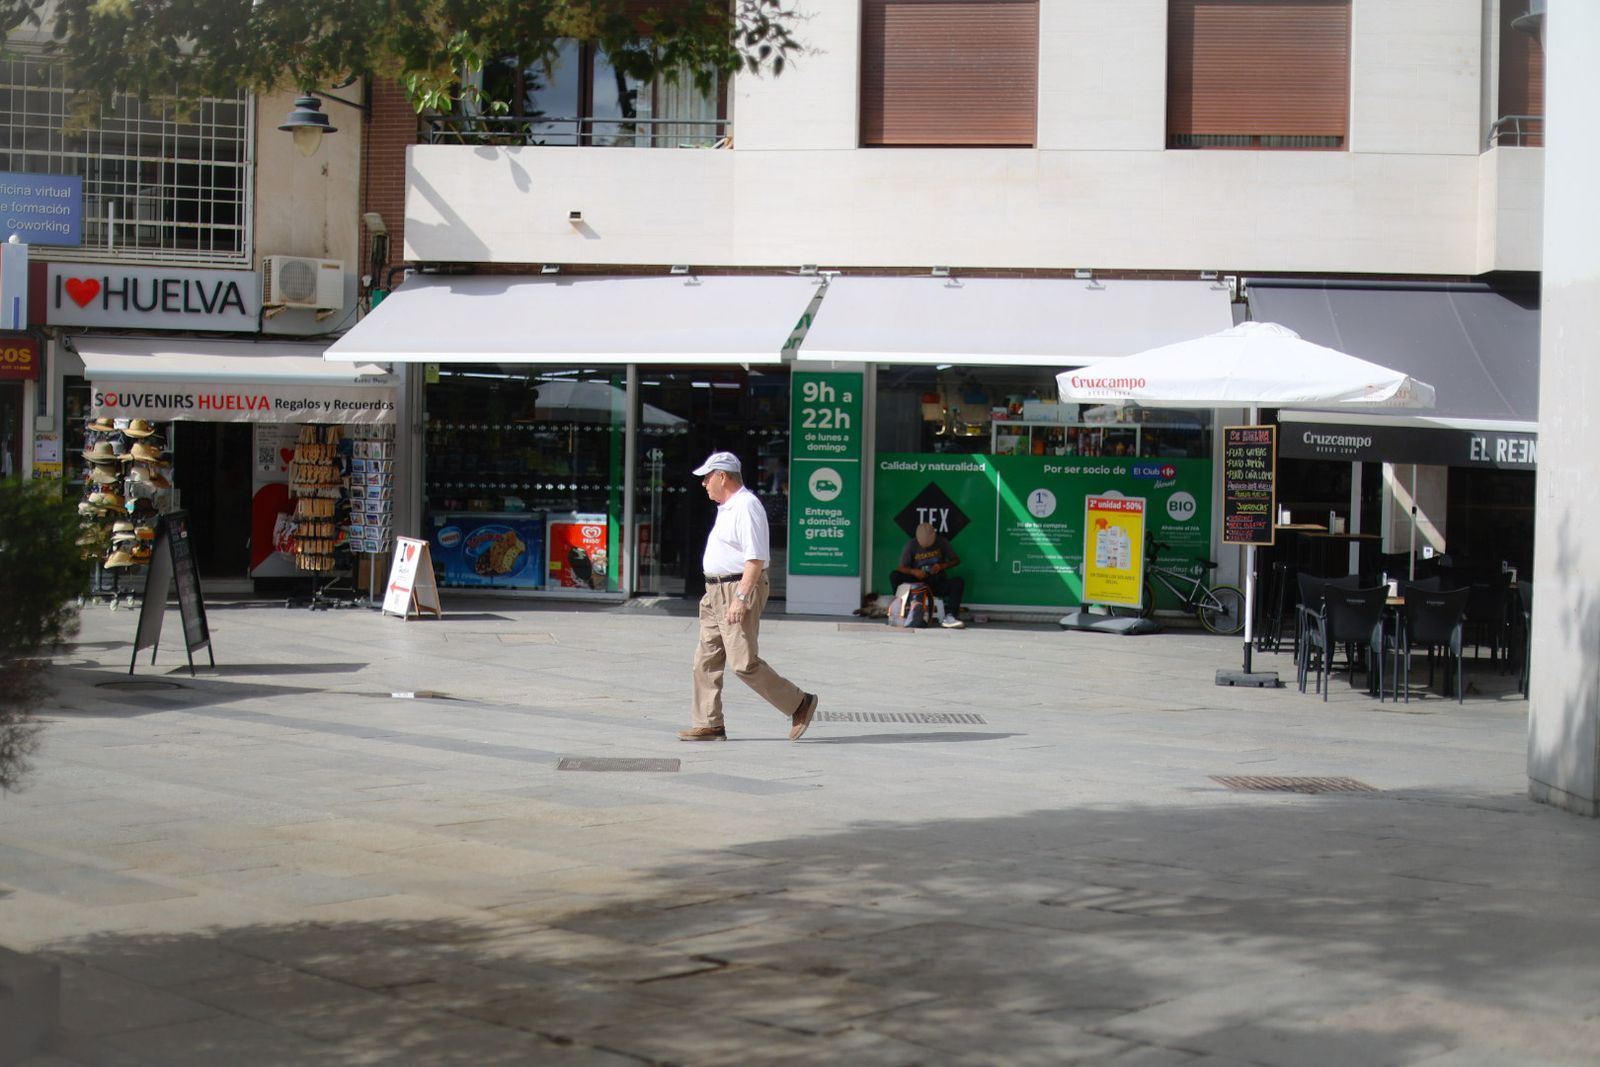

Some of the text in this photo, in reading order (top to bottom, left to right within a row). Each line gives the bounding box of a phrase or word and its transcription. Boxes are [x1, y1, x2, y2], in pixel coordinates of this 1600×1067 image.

[35, 186, 70, 198] virtual
[12, 202, 70, 215] formación
[8, 218, 70, 234] Coworking
[55, 274, 246, 315] I HUELVA
[1072, 376, 1146, 390] Cruzcampo
[802, 381, 852, 403] 9h a
[94, 393, 394, 412] SOUVENIRS HUELVA Regalos y Recuerdos
[802, 408, 850, 429] 22h
[804, 432, 816, 441] de
[818, 432, 842, 441] lunes
[1303, 431, 1372, 448] Cruzcampo
[807, 443, 847, 452] domingo
[1470, 438, 1490, 461] EL
[880, 462, 986, 472] Calidad y naturalidad
[1044, 464, 1062, 474] Por
[1064, 466, 1079, 474] ser
[1083, 465, 1110, 474] socio
[1113, 466, 1126, 475] de
[1098, 500, 1121, 509] unidad
[1168, 501, 1194, 512] BIO
[805, 508, 842, 518] Entrega
[807, 517, 850, 526] domicilio
[916, 508, 949, 532] TEX
[805, 526, 844, 540] gratis
